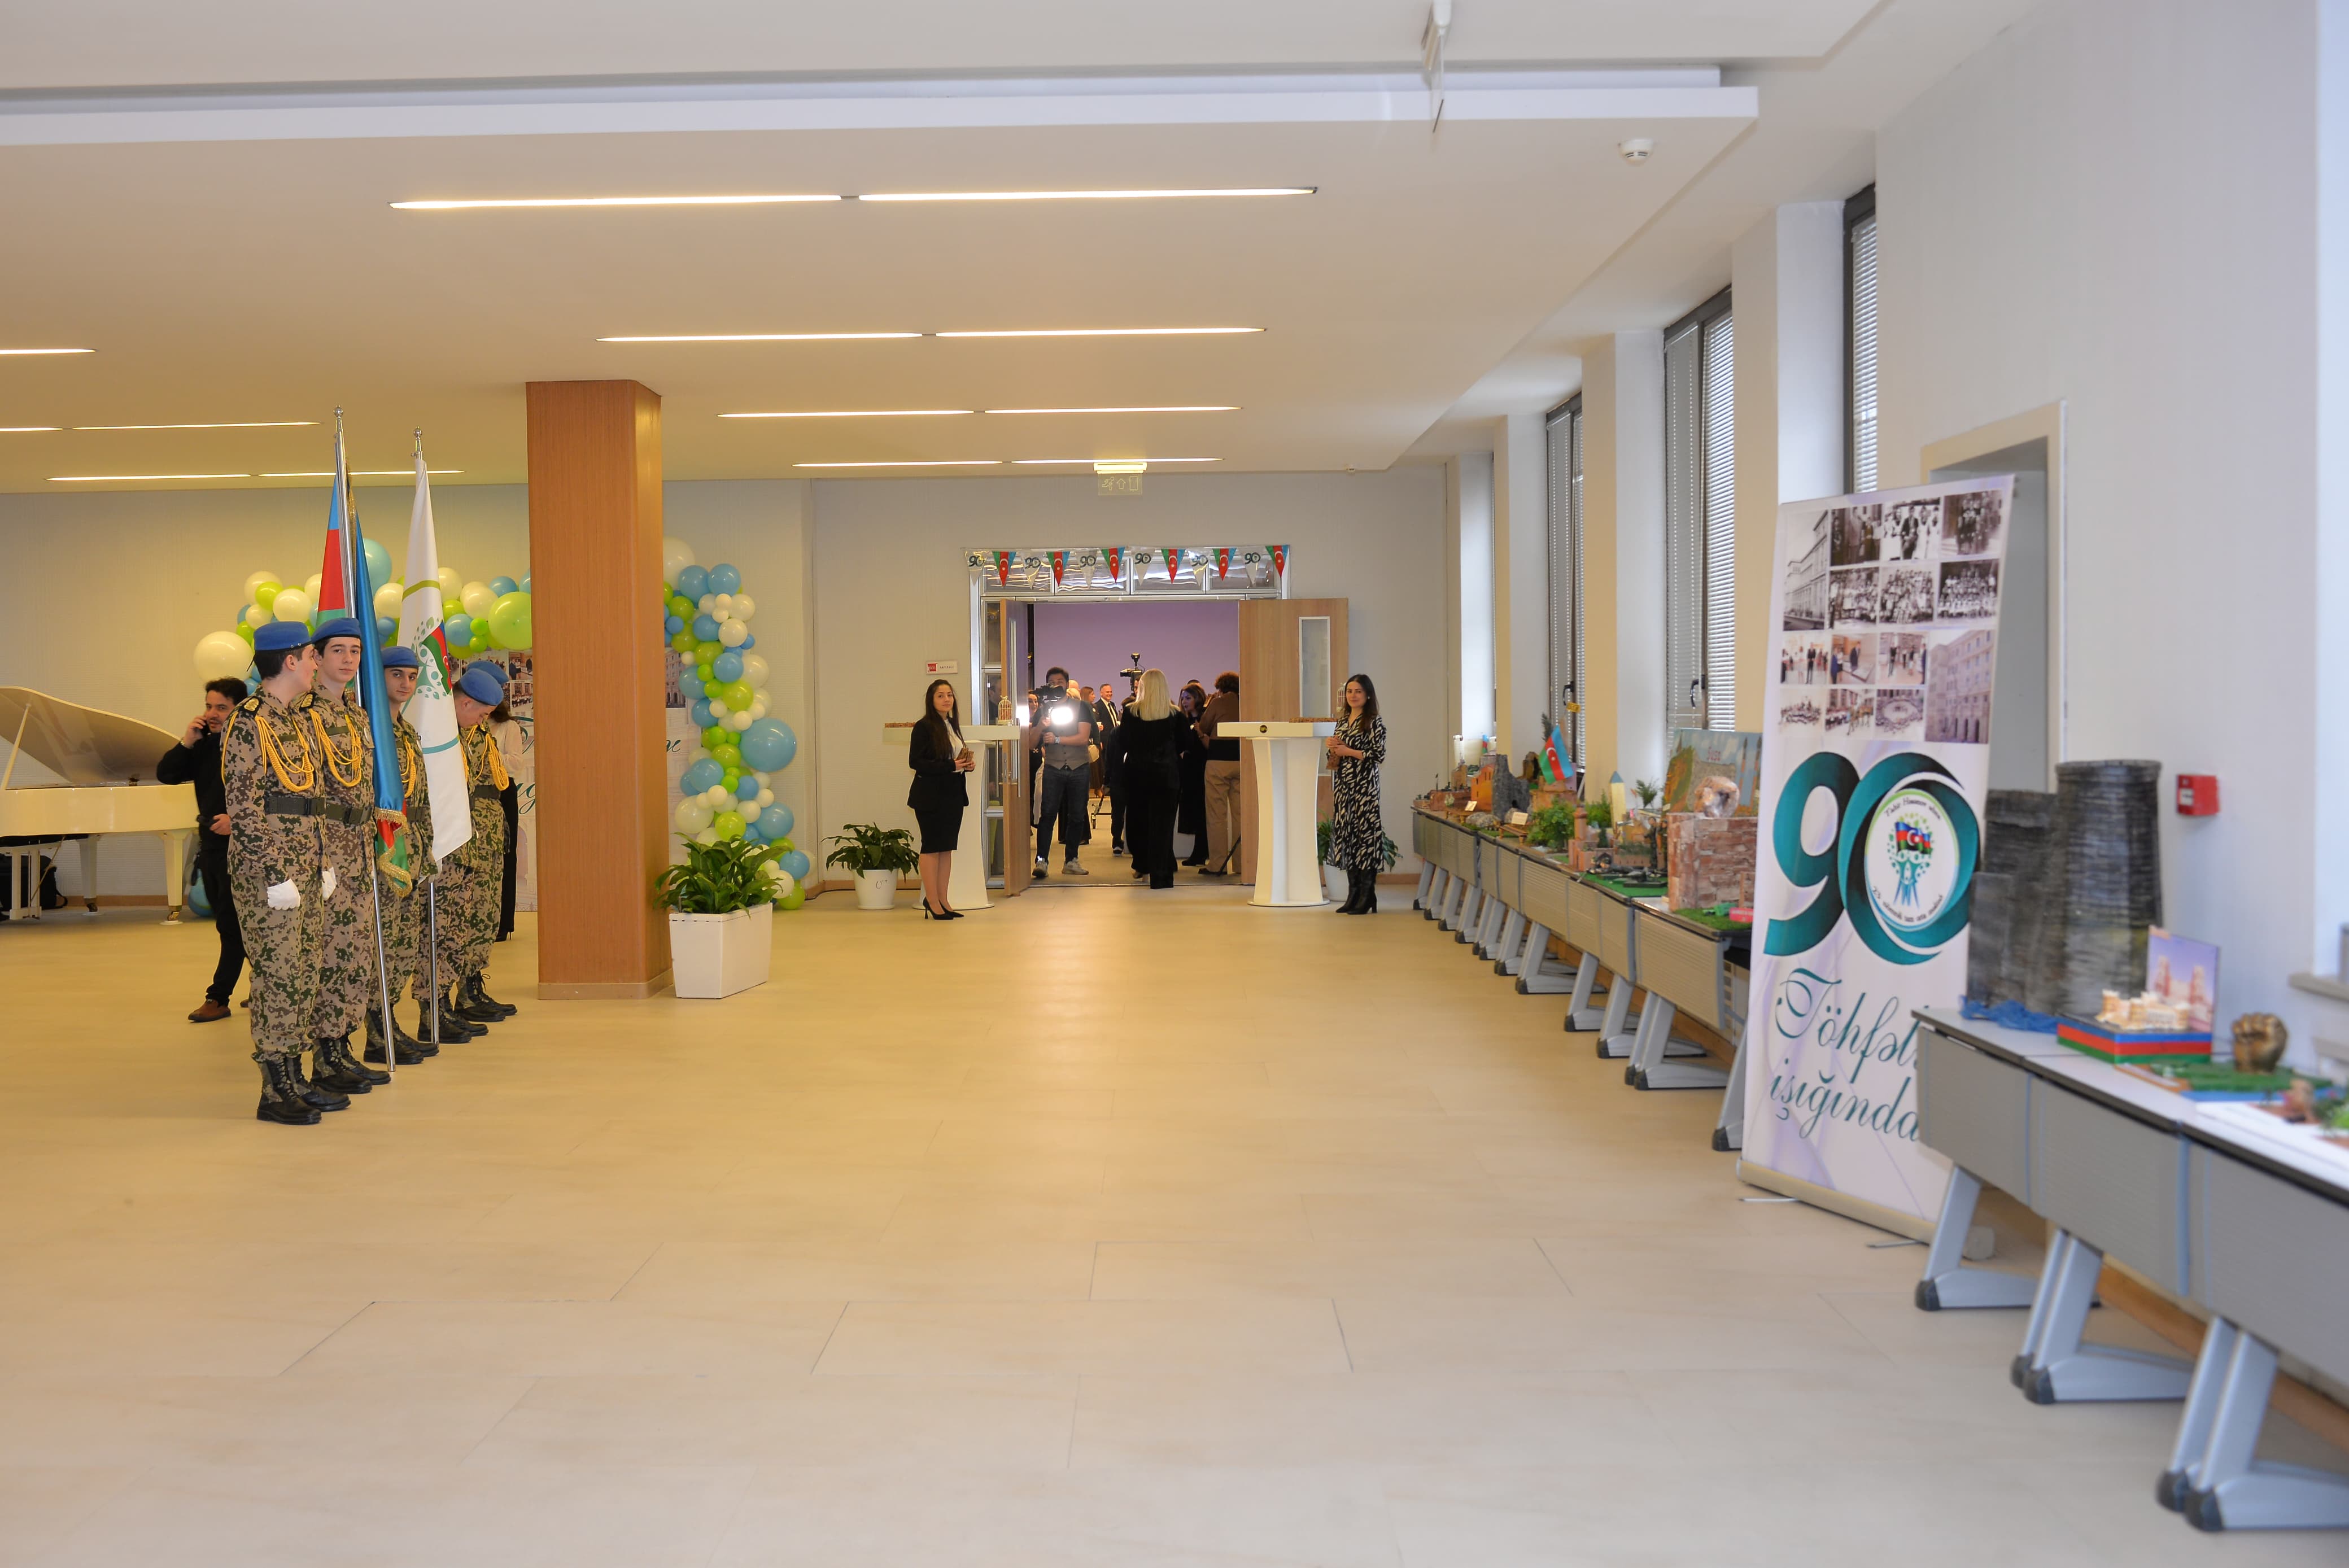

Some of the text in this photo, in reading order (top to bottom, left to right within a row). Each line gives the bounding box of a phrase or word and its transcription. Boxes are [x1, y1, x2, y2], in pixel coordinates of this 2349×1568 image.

[968, 555, 985, 567] 90
[1024, 556, 1041, 569] 90
[1080, 554, 1097, 568] 90
[1134, 553, 1151, 565] 90
[1191, 554, 1208, 567] 90
[1244, 552, 1261, 565] 90
[1763, 752, 1981, 966] 90
